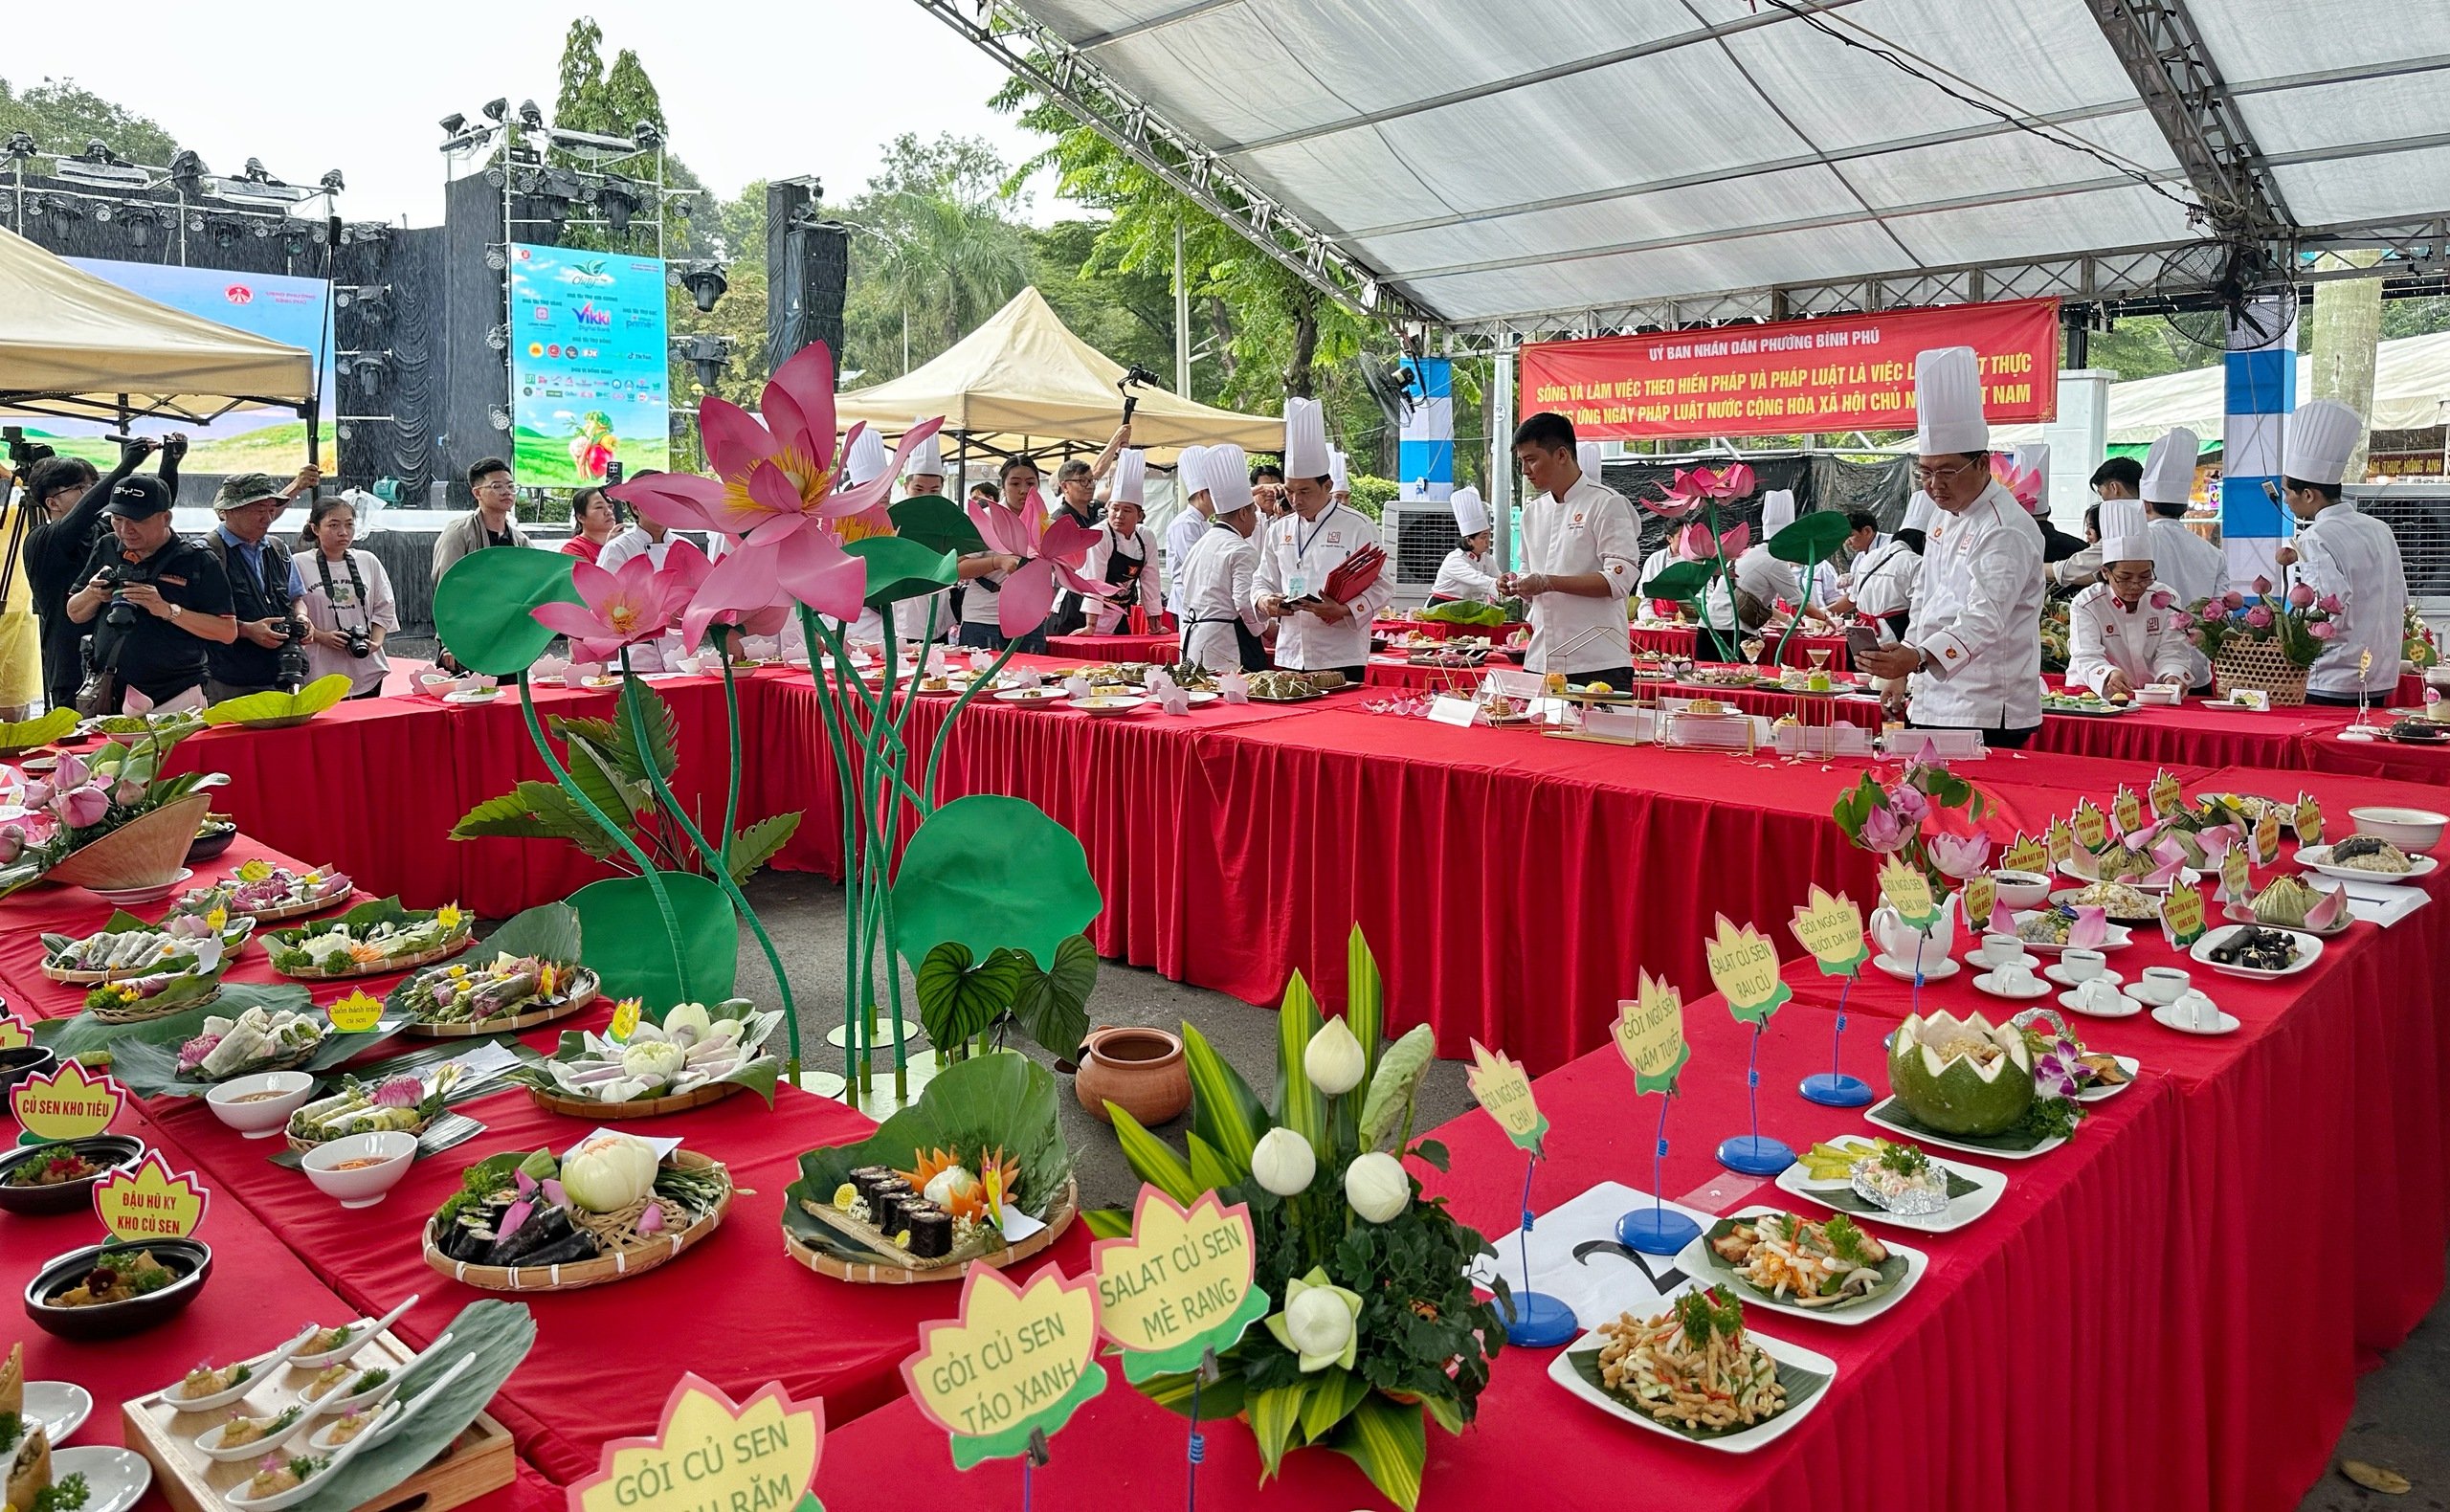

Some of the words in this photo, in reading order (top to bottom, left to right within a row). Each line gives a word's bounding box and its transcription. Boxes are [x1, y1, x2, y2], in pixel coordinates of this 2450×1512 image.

[572, 302, 610, 325] Vikki
[1666, 345, 1691, 361] BAN
[1694, 340, 1728, 358] NHÂN
[1731, 338, 1757, 355] DÂN
[1760, 334, 1813, 353] PHƯỜNG
[1816, 331, 1848, 348] BÌNH
[1852, 326, 1880, 345] PHÚ
[1537, 381, 1568, 403] SỐNG
[1570, 382, 1584, 402] VÀ
[1586, 380, 1612, 400] LÀM
[1615, 378, 1641, 402] VIỆC
[1644, 378, 1675, 397] THEO
[1678, 371, 1708, 395] HIẾN
[1711, 370, 1747, 392] PHÁP
[1749, 368, 1768, 390] VÀ
[1771, 367, 1808, 389] PHÁP
[1811, 364, 1846, 389] LUẬT
[1849, 362, 1867, 384] LÀ
[1870, 360, 1904, 386] VIỆC
[1992, 351, 2032, 378] THỰC
[1576, 406, 1601, 426] ỨNG
[1603, 404, 1636, 424] NGÀY
[1637, 402, 1671, 423] PHÁP
[1674, 400, 1704, 424] LUẬT
[1706, 397, 1743, 419] NƯỚC
[1747, 395, 1784, 421] CỘNG
[1787, 392, 1815, 415] HÒA
[1819, 391, 1838, 413] XÃ
[1841, 390, 1867, 415] HỘI
[1870, 386, 1902, 411] CHỦ
[1993, 383, 2032, 405] NAM
[2426, 459, 2441, 473] ANH
[114, 486, 145, 498] BYD
[1911, 878, 1924, 890] SEN
[1800, 919, 1817, 935] GỎI
[1817, 911, 1837, 929] NGÓ
[1837, 910, 1851, 924] SEN
[1810, 935, 1833, 953] BƯỞI
[1832, 933, 1846, 946] DA
[1845, 927, 1860, 942] XANH
[1711, 953, 1736, 975] SALAT
[1735, 944, 1750, 967] CỦ
[1749, 943, 1771, 962] SEN
[1736, 979, 1756, 999] RAU
[1755, 968, 1771, 992] CỦ
[1623, 1012, 1646, 1040] GỎI
[1646, 999, 1663, 1030] NGÓ
[1662, 994, 1677, 1017] SEN
[1635, 1045, 1659, 1073] NẤM
[1659, 1027, 1682, 1059] TUYẾT
[22, 1095, 37, 1115] CỦ
[39, 1101, 61, 1115] SEN
[63, 1101, 83, 1116] KHO
[86, 1101, 109, 1118] TIÊU
[1481, 1087, 1501, 1112] GỎI
[1497, 1078, 1517, 1106] NGÓ
[1511, 1078, 1528, 1098] SEN
[1510, 1107, 1533, 1130] CHAY
[122, 1192, 143, 1211] ĐẬU
[146, 1192, 161, 1210] HŨ
[164, 1197, 177, 1211] KY
[118, 1215, 139, 1231] KHO
[142, 1213, 156, 1233] CỦ
[158, 1220, 180, 1234] SEN
[1100, 1255, 1168, 1308] SALAT
[1172, 1234, 1201, 1273] CỦ
[1202, 1223, 1241, 1259] SEN
[1143, 1298, 1180, 1344] MÈ
[1181, 1278, 1237, 1324] RANG
[933, 1351, 978, 1395] GỎI
[982, 1329, 1013, 1371] CỦ
[1018, 1312, 1065, 1354] SEN
[960, 1391, 1012, 1434] TÁO
[1013, 1358, 1079, 1410] XANH
[615, 1458, 675, 1507] GỎI
[683, 1435, 724, 1481] CỦ
[733, 1421, 790, 1464] SEN
